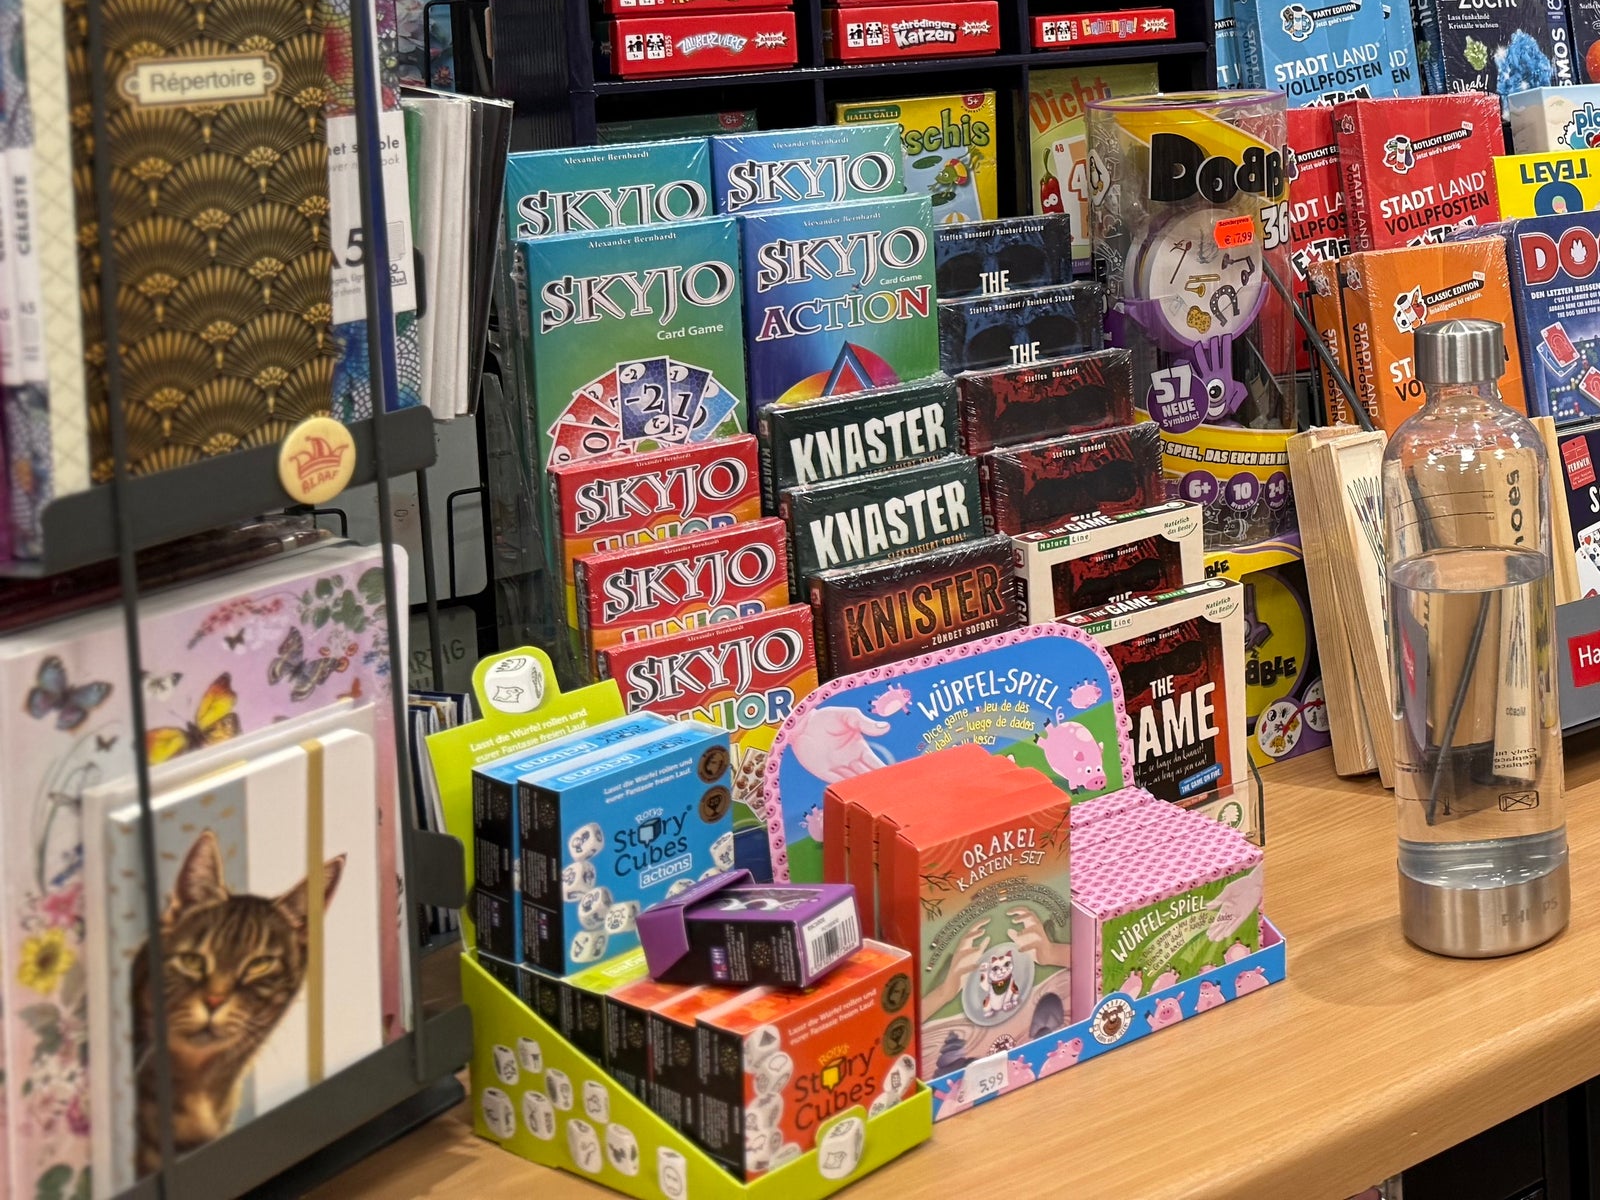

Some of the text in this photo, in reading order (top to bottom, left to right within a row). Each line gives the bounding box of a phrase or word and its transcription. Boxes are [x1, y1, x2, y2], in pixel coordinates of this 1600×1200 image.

[891, 19, 957, 33] Schrödingers
[895, 26, 957, 48] Katzen
[150, 67, 256, 93] Répertoire
[847, 110, 899, 121] HALLI GALLI
[1442, 128, 1468, 145] EDITION
[1380, 174, 1484, 220] STADT LAND
[1385, 191, 1490, 237] VOLLPFOSTEN
[588, 232, 677, 249] Alexander Bernhardt
[757, 226, 928, 293] SKYJO
[979, 270, 1010, 295] THE
[1426, 280, 1479, 304] CLASSIC EDITION
[1531, 291, 1545, 299] DEN
[1547, 287, 1573, 299] LETZTEN
[540, 260, 736, 334] SKYJO
[755, 285, 930, 342] ACTION
[657, 321, 723, 341] Card Game
[1150, 363, 1191, 399] 57
[1161, 399, 1196, 418] NEUE
[1162, 412, 1200, 427] Symbole!
[810, 479, 971, 570] KNASTER
[940, 533, 967, 548] TOTAL!
[843, 563, 1003, 659] KNISTER
[931, 618, 999, 646] ZÜNDET SOFORT!
[627, 627, 803, 715] SKYJO
[1149, 674, 1174, 694] THE
[983, 700, 1029, 714] Jeu de dés
[922, 707, 969, 745] Dice game
[965, 717, 1035, 735] Juego de dados
[613, 835, 689, 878] Cubes
[962, 827, 1036, 870] ORAKEL
[642, 856, 691, 886] actions
[955, 850, 1046, 893] KARTEN-SET
